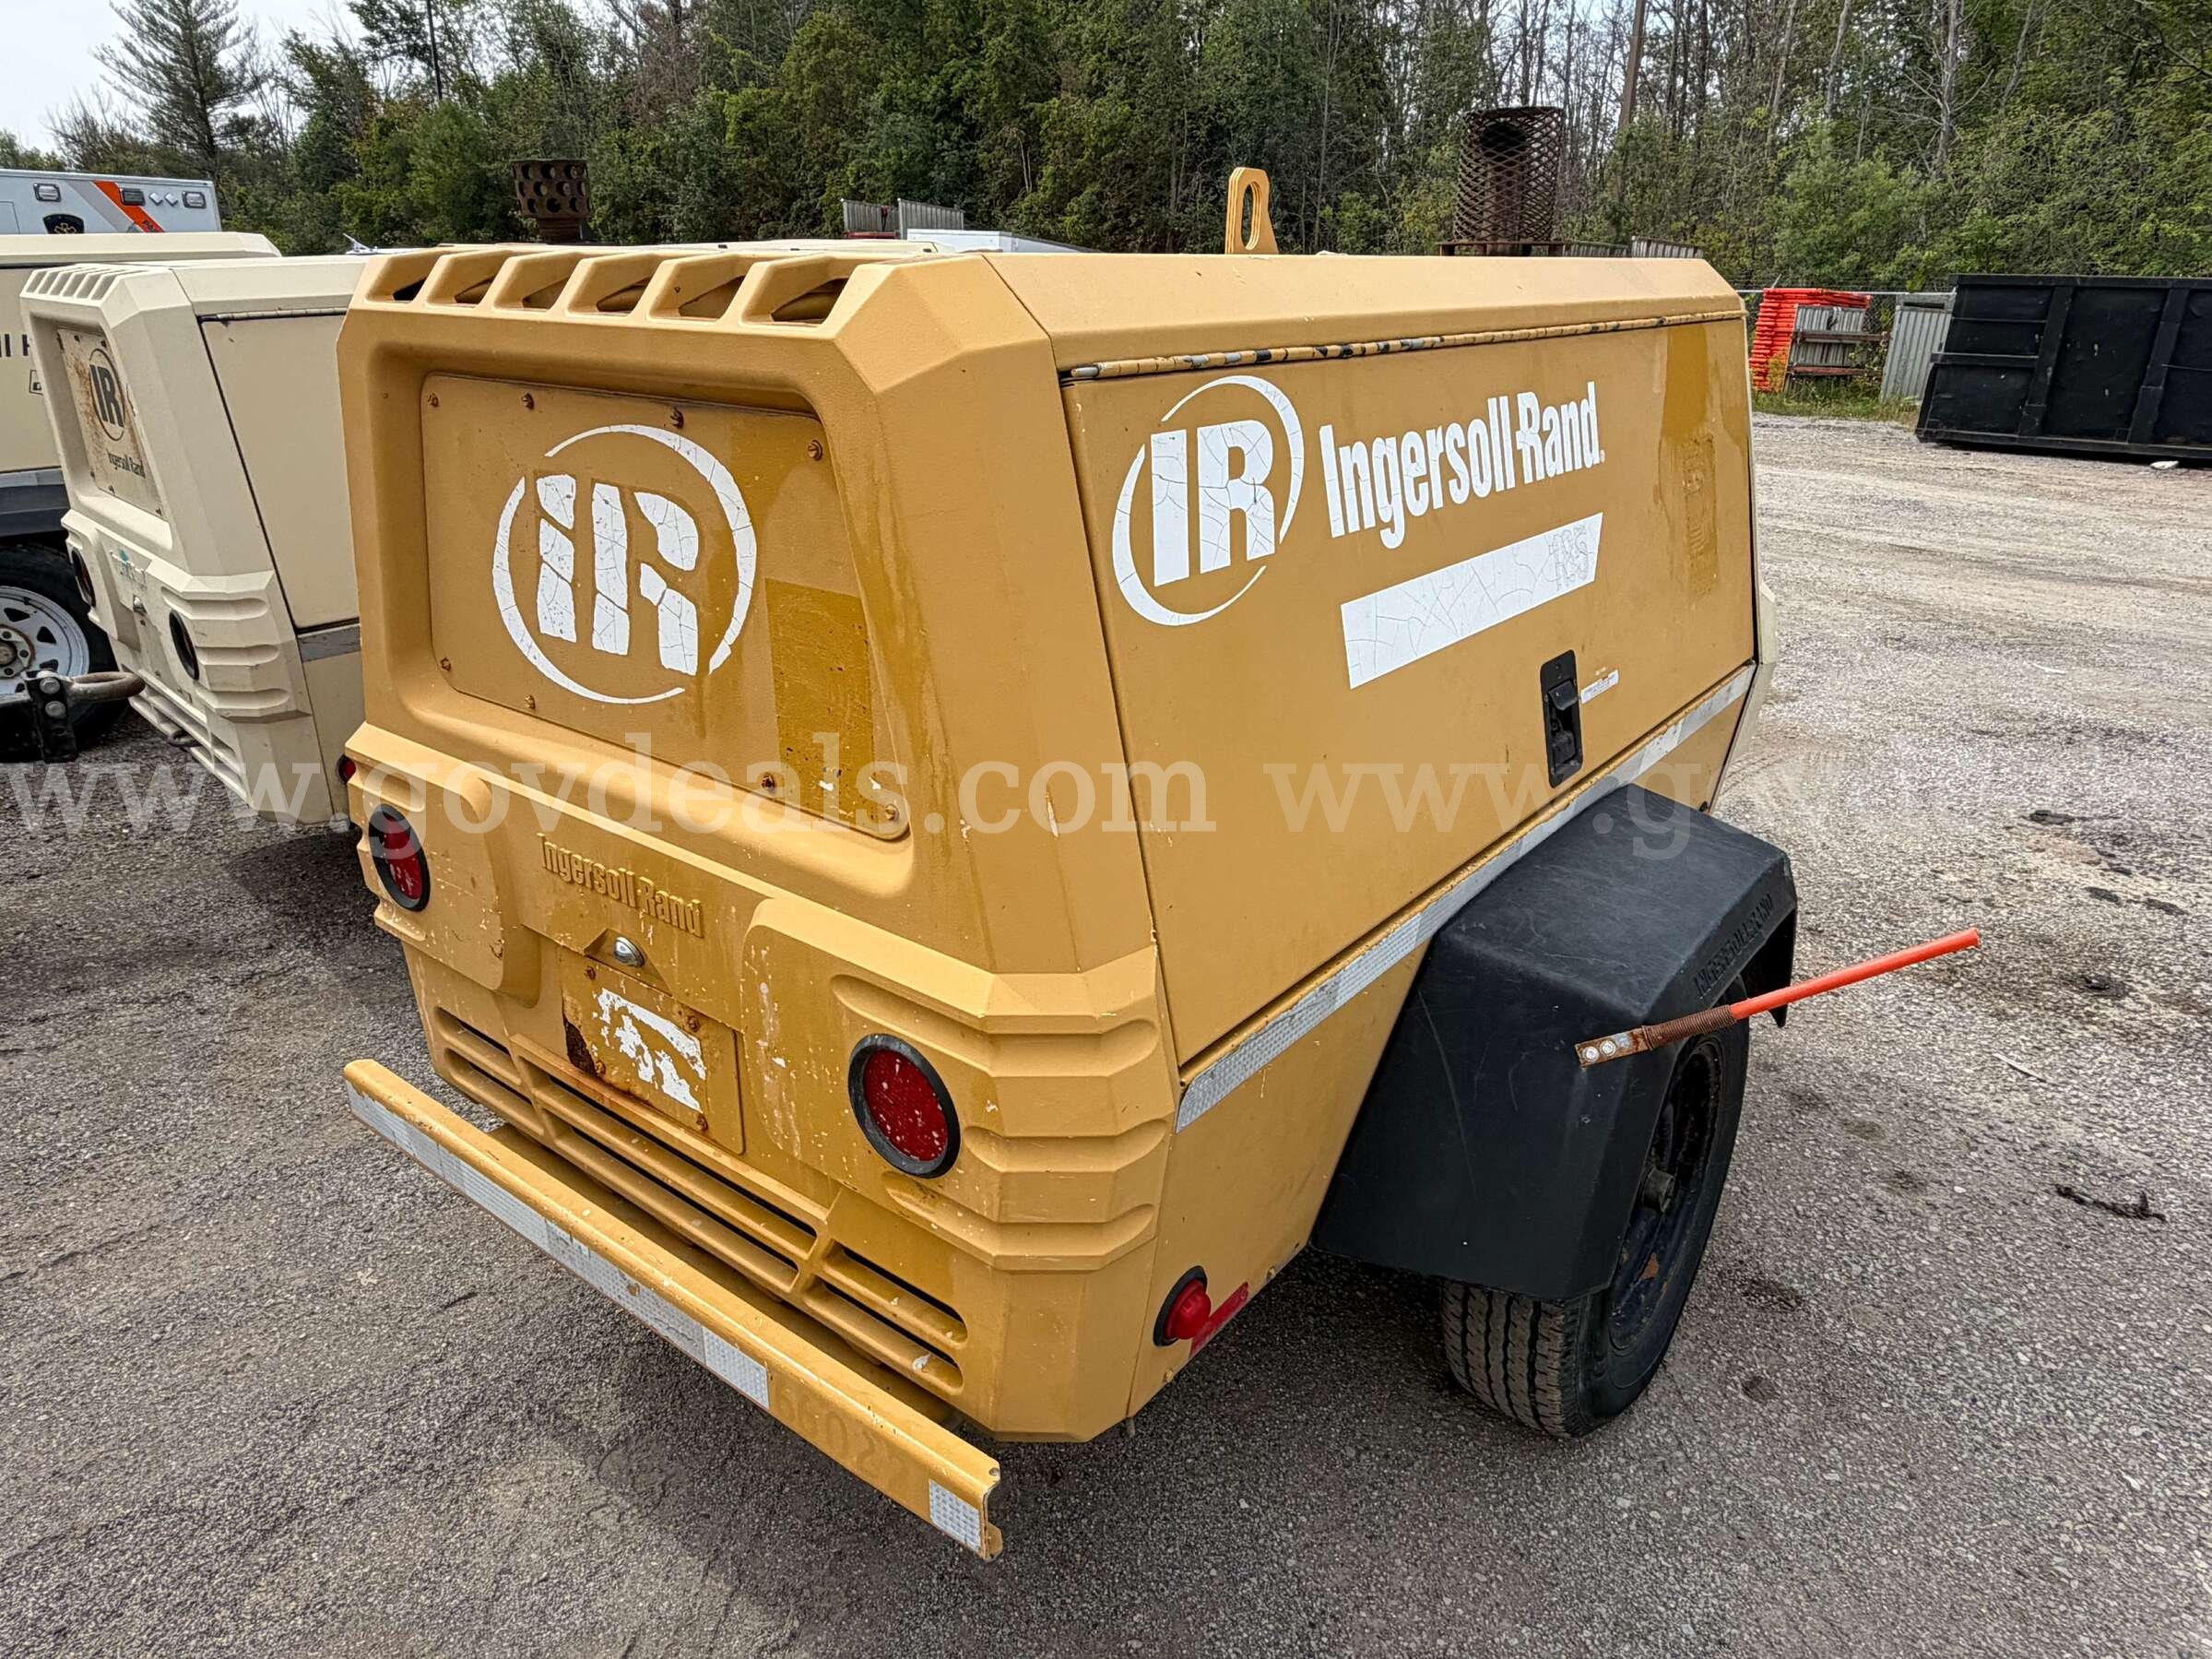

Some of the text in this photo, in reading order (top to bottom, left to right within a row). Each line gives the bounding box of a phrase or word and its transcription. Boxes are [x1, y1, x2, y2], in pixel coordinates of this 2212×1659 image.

[89, 364, 124, 428] IR
[536, 472, 699, 676] IR
[1151, 420, 1276, 587] IR
